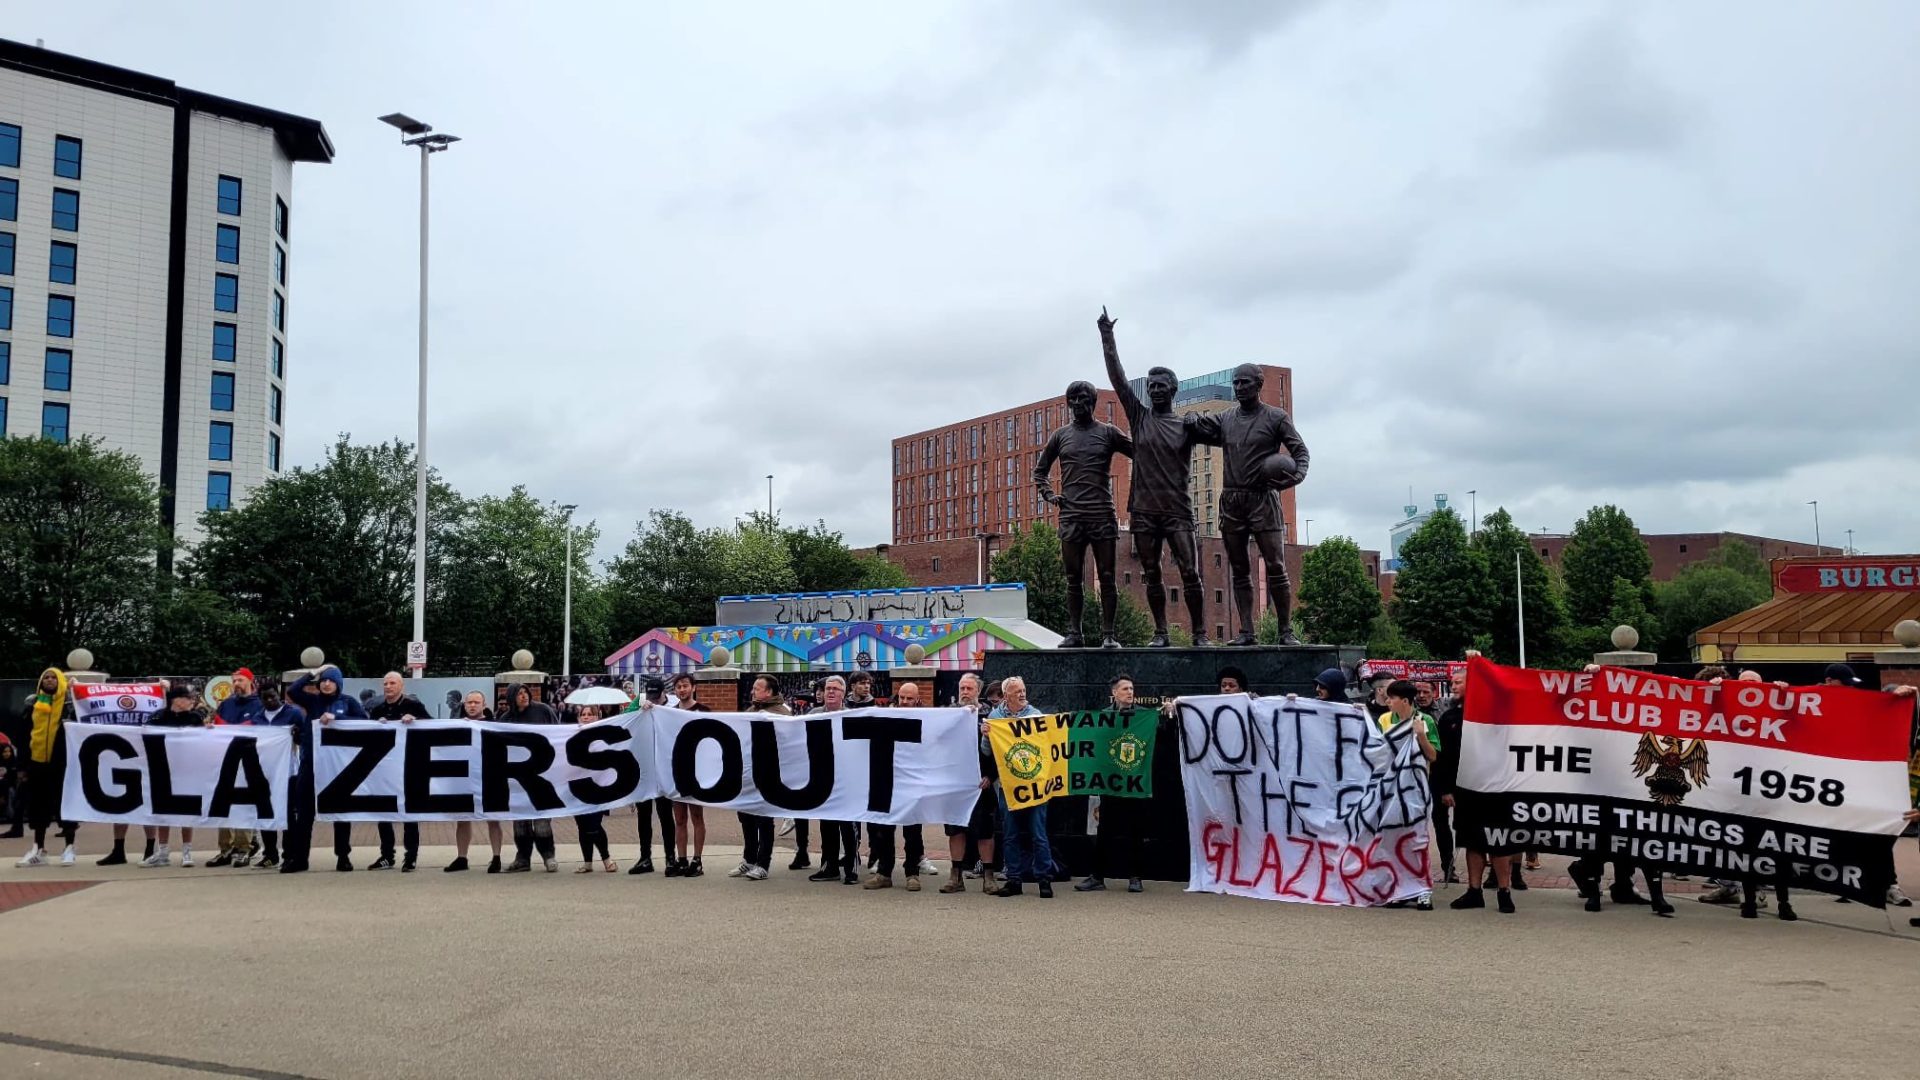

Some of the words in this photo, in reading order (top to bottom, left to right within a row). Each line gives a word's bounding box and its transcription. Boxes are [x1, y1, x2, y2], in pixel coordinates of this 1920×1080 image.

[1818, 566, 1920, 588] BURG
[1539, 672, 1594, 695] WE
[1605, 670, 1721, 705] WANT
[1738, 687, 1823, 717] OUR
[116, 712, 139, 723] SALE
[1008, 716, 1048, 738] WE
[1055, 710, 1136, 729] WANT
[1563, 698, 1661, 728] CLUB
[1678, 709, 1788, 743] BACK
[671, 716, 923, 814] OUT
[1050, 740, 1095, 763] OUR
[1013, 775, 1065, 804] CLUB
[1071, 772, 1145, 793] BACK
[1509, 744, 1592, 775] THE
[1732, 766, 1846, 807] 1958
[1212, 769, 1318, 838] THE
[1512, 801, 1600, 826] SOME
[1612, 806, 1745, 846] THINGS
[1757, 829, 1831, 860] ARE
[1202, 823, 1398, 904] GLAZERS
[1484, 826, 1597, 851] WORTH
[1610, 834, 1777, 875] FIGHTING
[1792, 861, 1862, 890] FOR
